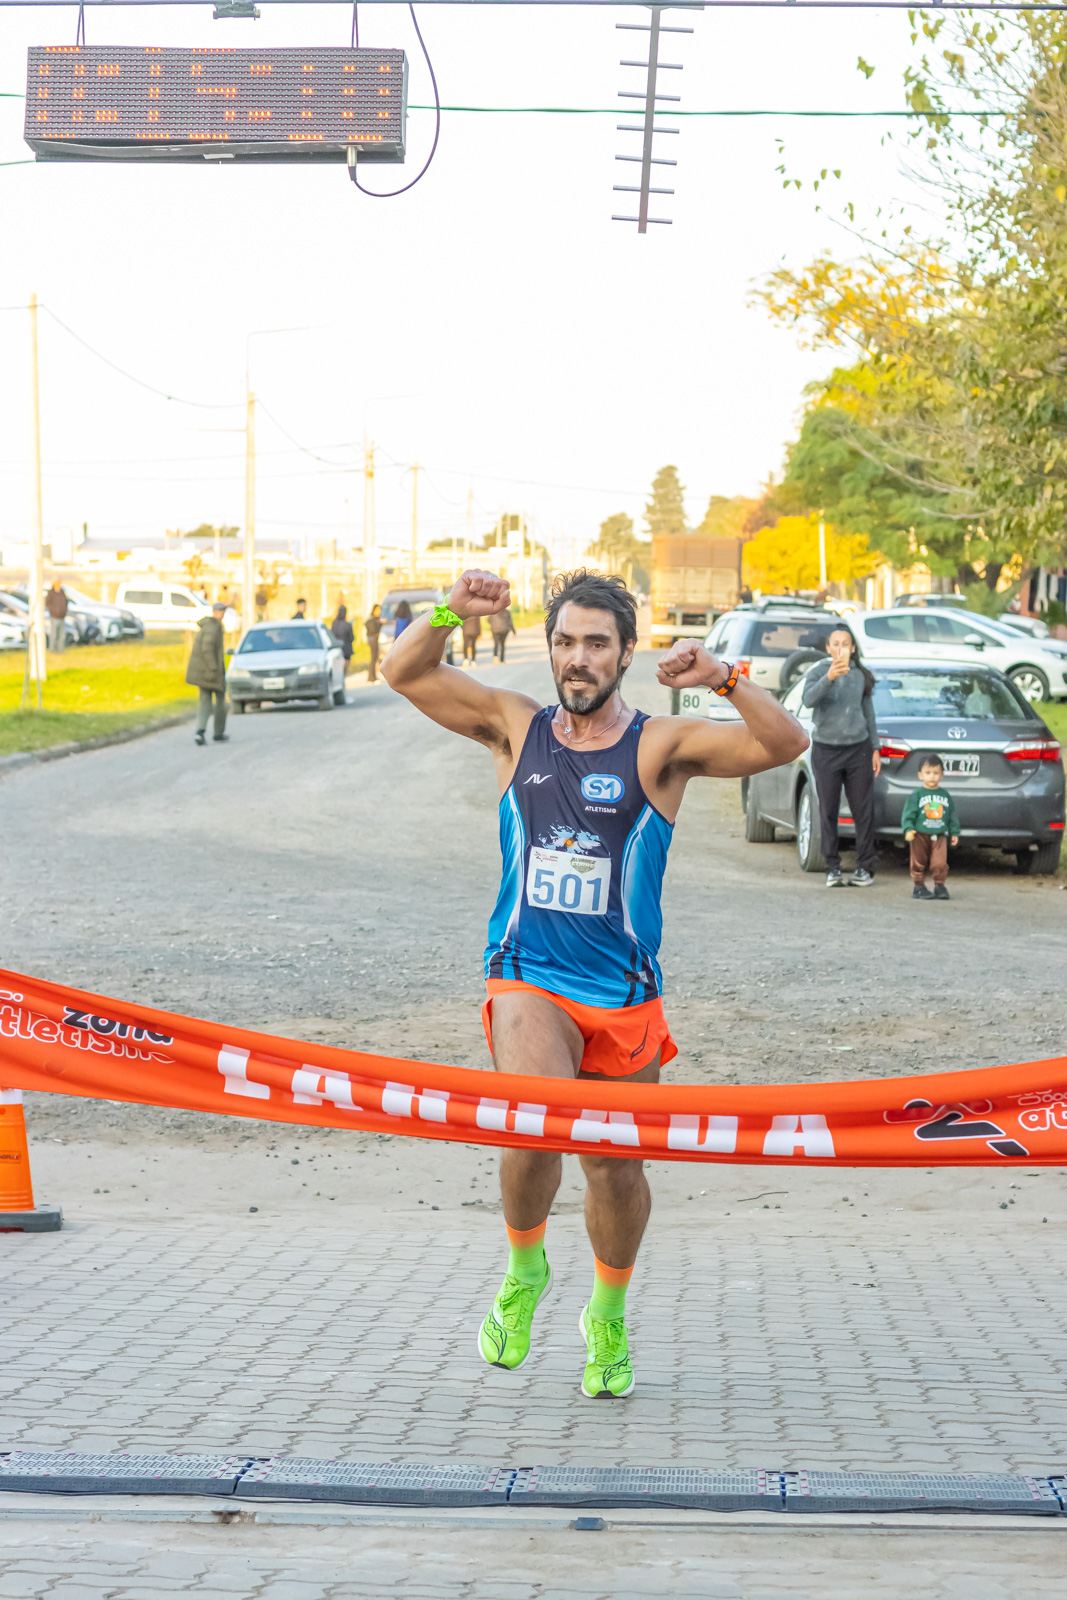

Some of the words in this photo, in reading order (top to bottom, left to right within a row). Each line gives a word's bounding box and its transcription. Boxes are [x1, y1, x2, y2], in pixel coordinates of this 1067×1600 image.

[683, 694, 700, 708] 80
[584, 805, 618, 814] ATLETISMO
[532, 868, 602, 911] 501
